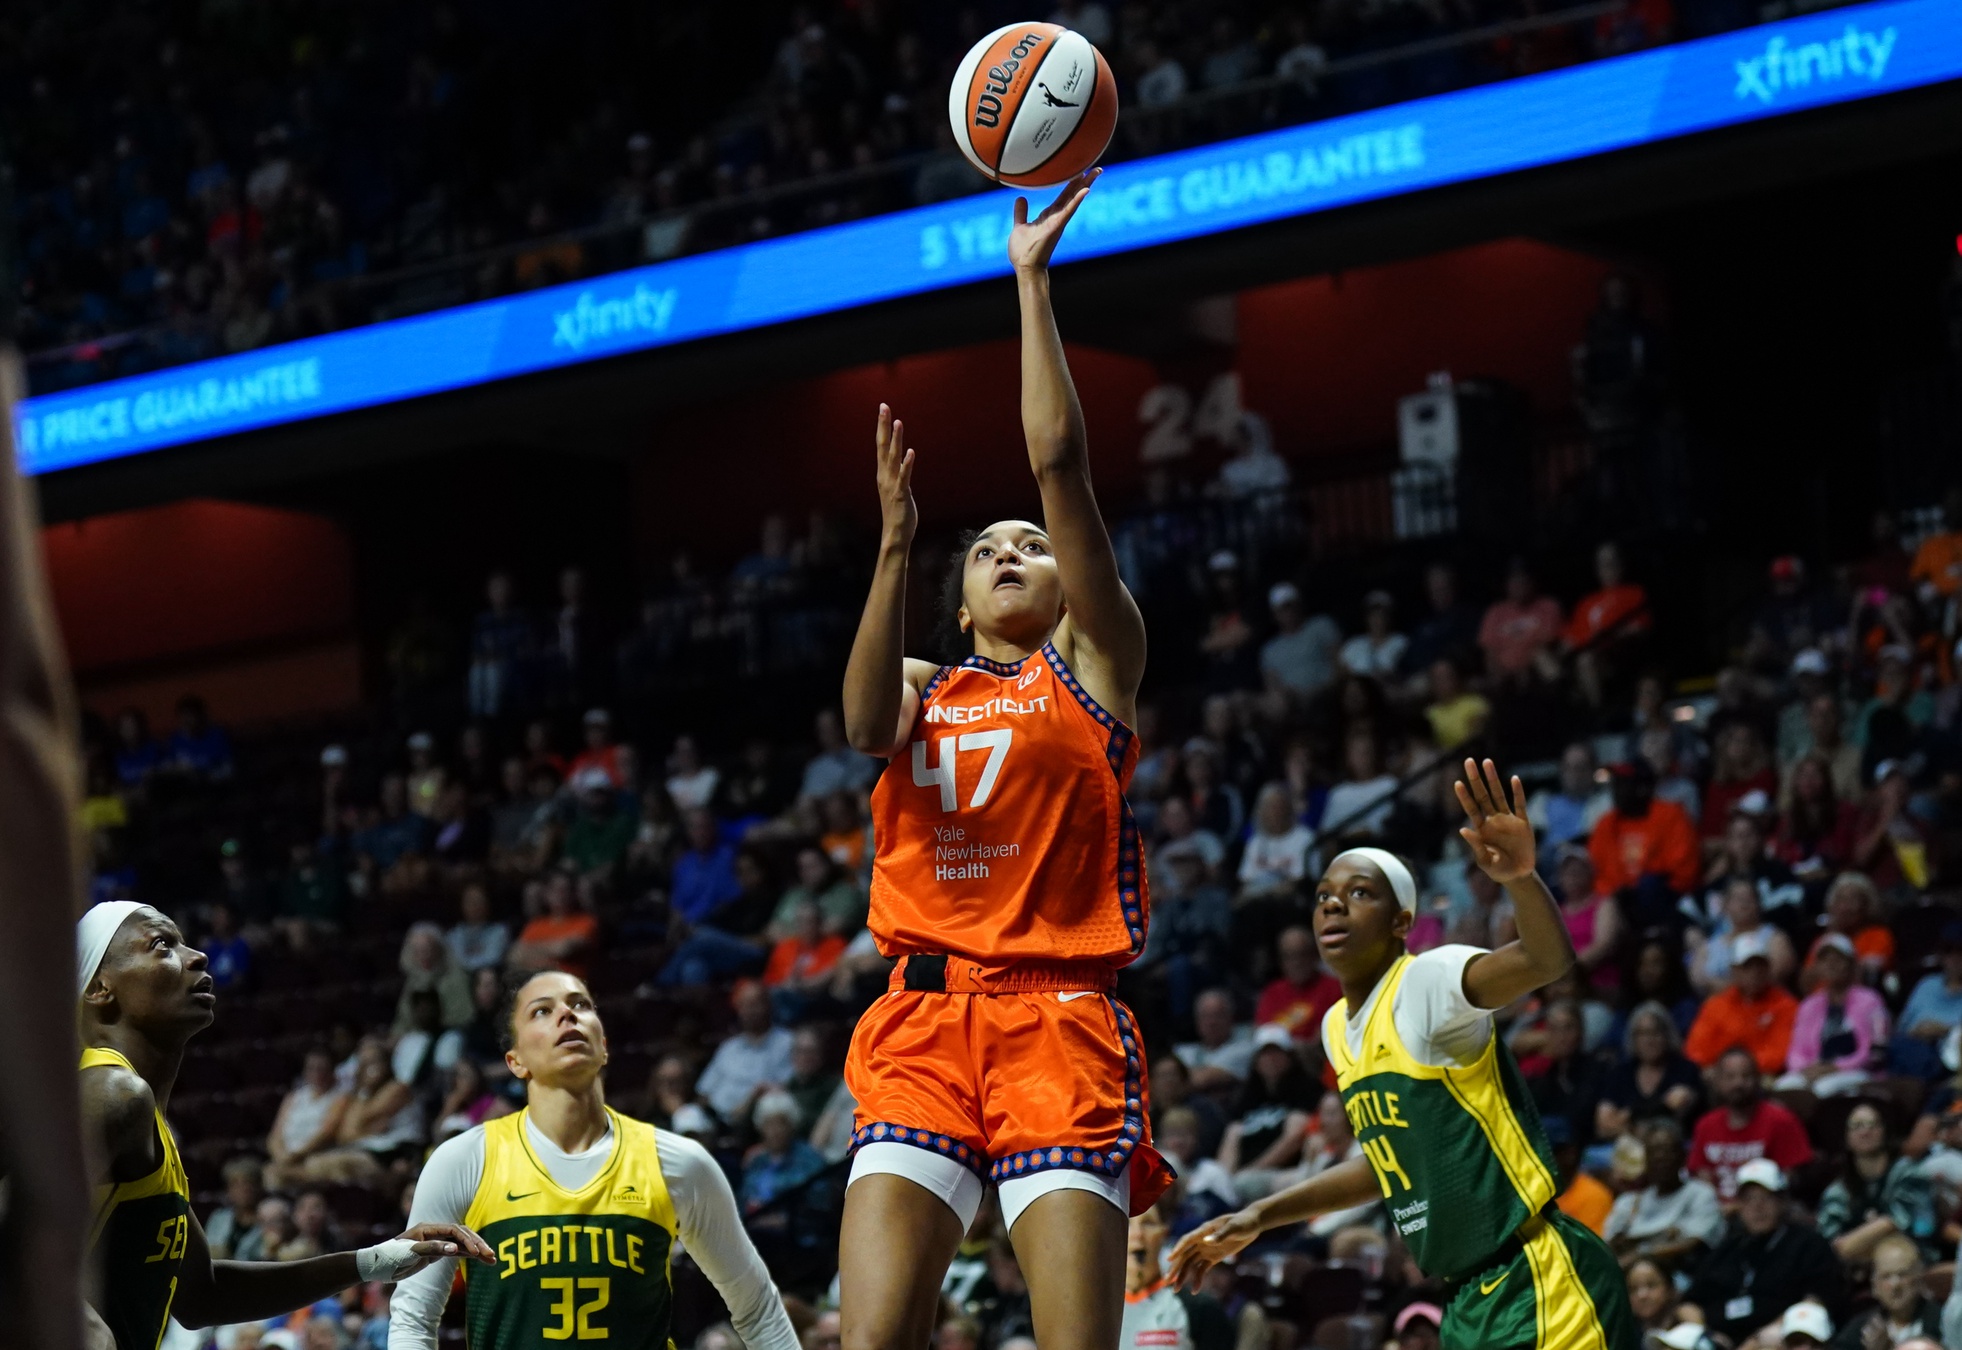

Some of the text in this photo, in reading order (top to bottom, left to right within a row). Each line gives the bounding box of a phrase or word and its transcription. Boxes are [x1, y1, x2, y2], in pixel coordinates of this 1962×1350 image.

[975, 33, 1044, 128] Wilson
[1734, 25, 1897, 103] xfinity
[921, 223, 947, 270] 5
[1179, 123, 1425, 215] GUARANTEE
[553, 284, 678, 349] xfinity
[42, 397, 130, 448] PRICE
[132, 356, 320, 433] GUARANTEE
[1138, 375, 1243, 462] 24
[924, 696, 1048, 724] NNECTICUT
[912, 728, 1013, 813] 47
[934, 826, 965, 843] Yale
[935, 862, 990, 881] Health
[1361, 1134, 1412, 1199] 14
[498, 1225, 645, 1280] SEATTLE
[540, 1277, 610, 1340] 32
